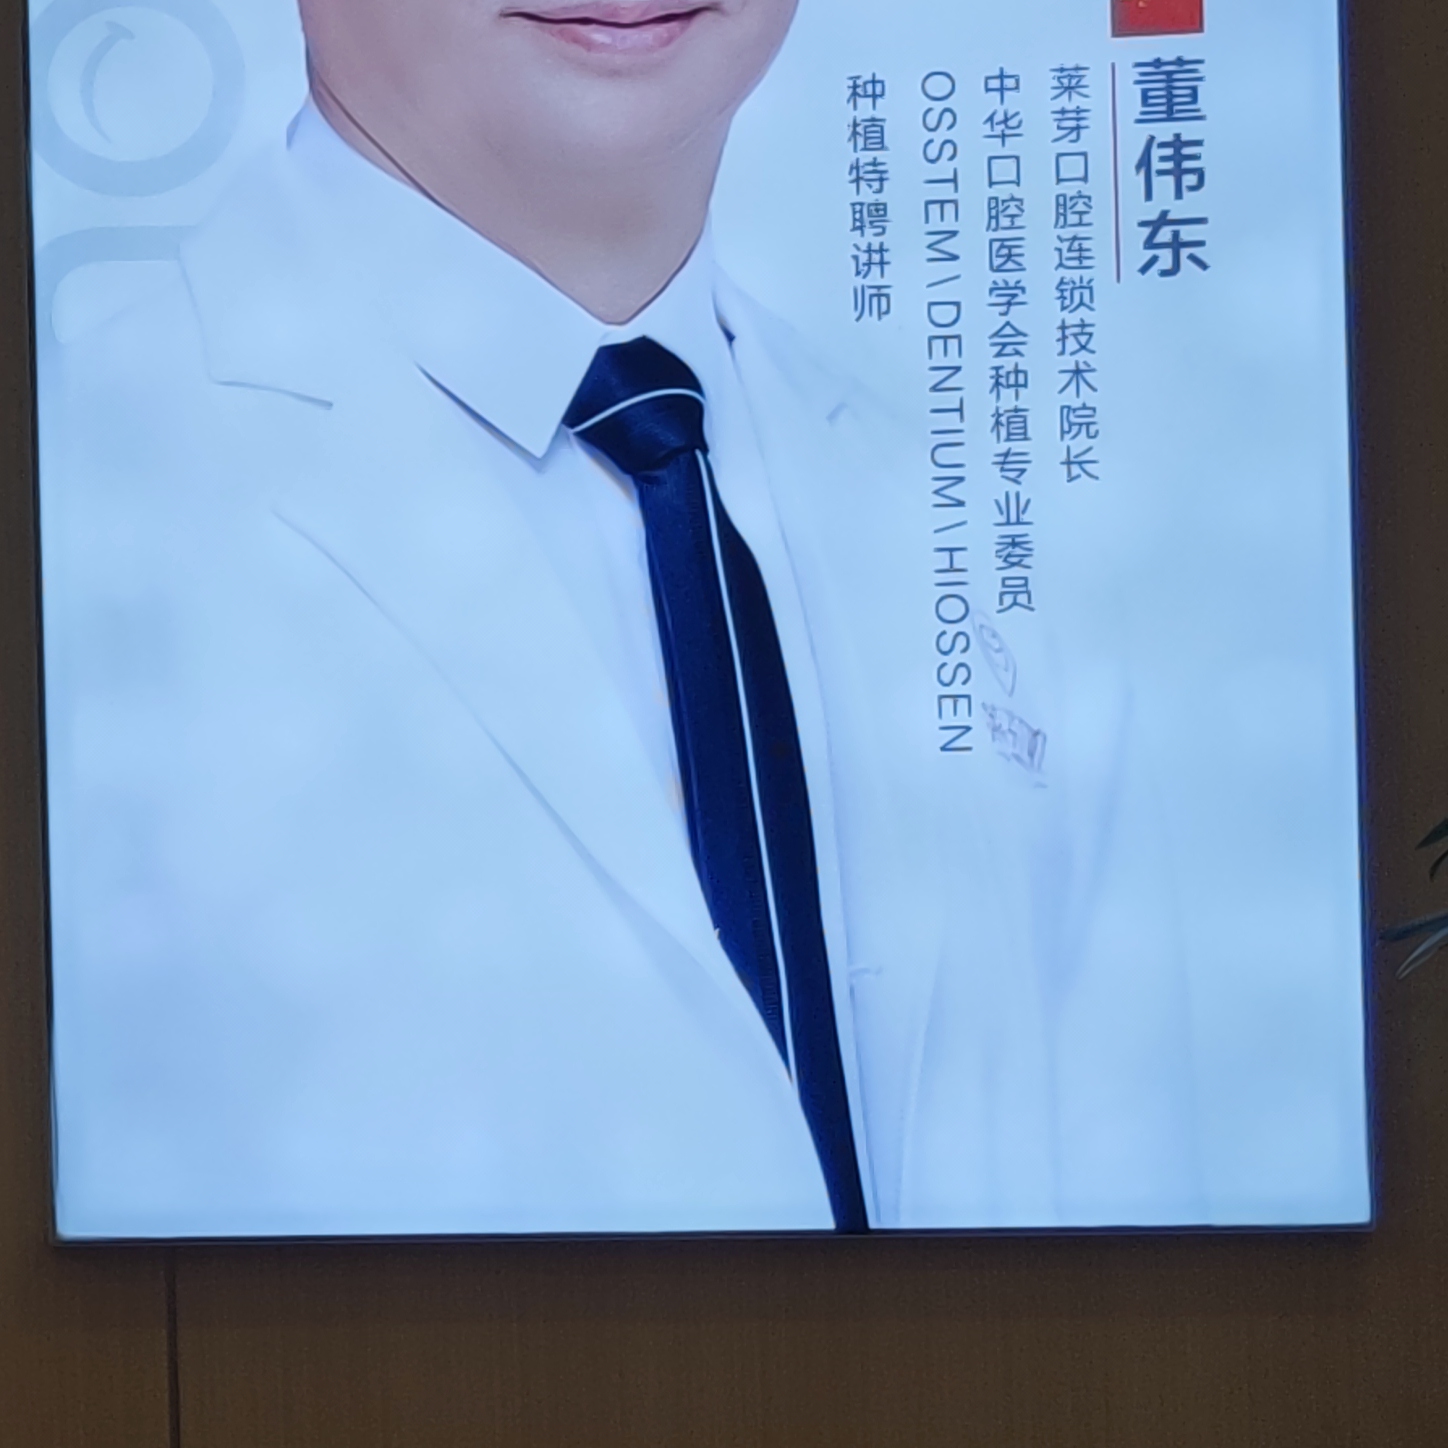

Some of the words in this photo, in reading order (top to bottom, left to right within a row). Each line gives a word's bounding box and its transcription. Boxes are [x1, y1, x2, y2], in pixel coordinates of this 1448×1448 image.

[846, 71, 894, 323] 种植特聘讲师
[1048, 63, 1100, 484] 莱芽口腔连锁技术院长
[1131, 55, 1212, 279] 董伟东
[982, 66, 1036, 615] 中华口腔医学会种植专业委员
